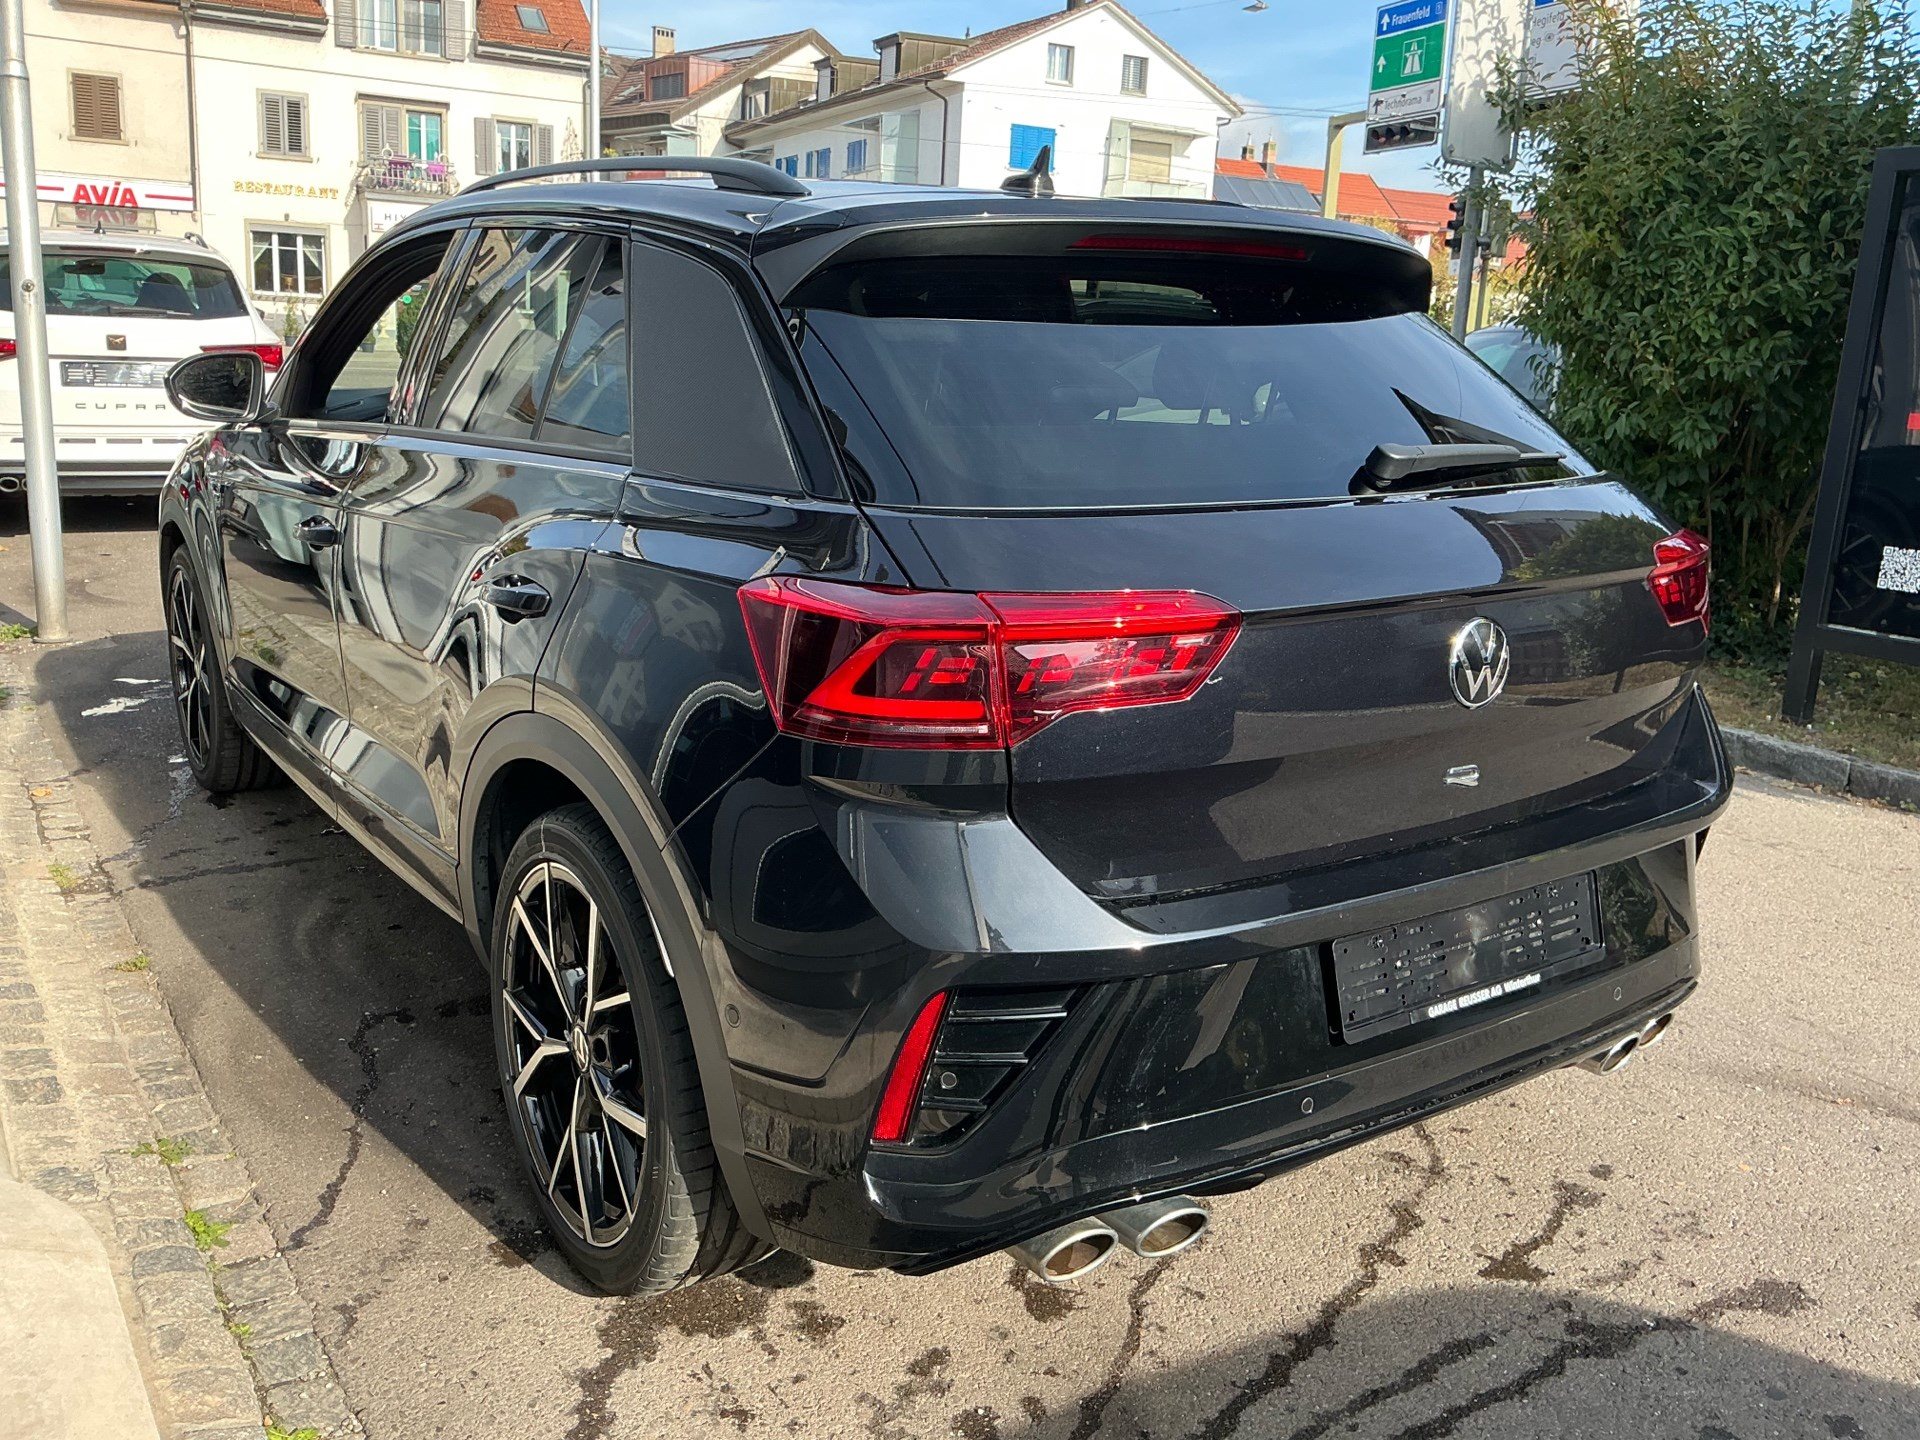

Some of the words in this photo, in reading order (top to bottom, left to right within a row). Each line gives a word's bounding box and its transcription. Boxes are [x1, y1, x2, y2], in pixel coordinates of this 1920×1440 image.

[1391, 4, 1431, 26] Frauenfeld
[233, 180, 339, 200] RESTAURANT
[75, 402, 166, 411] CUPRA
[1428, 999, 1459, 1018] GARAGE
[1458, 989, 1491, 1008] REUSSER
[1491, 984, 1503, 999] AG
[1503, 973, 1541, 993] Winterthur
